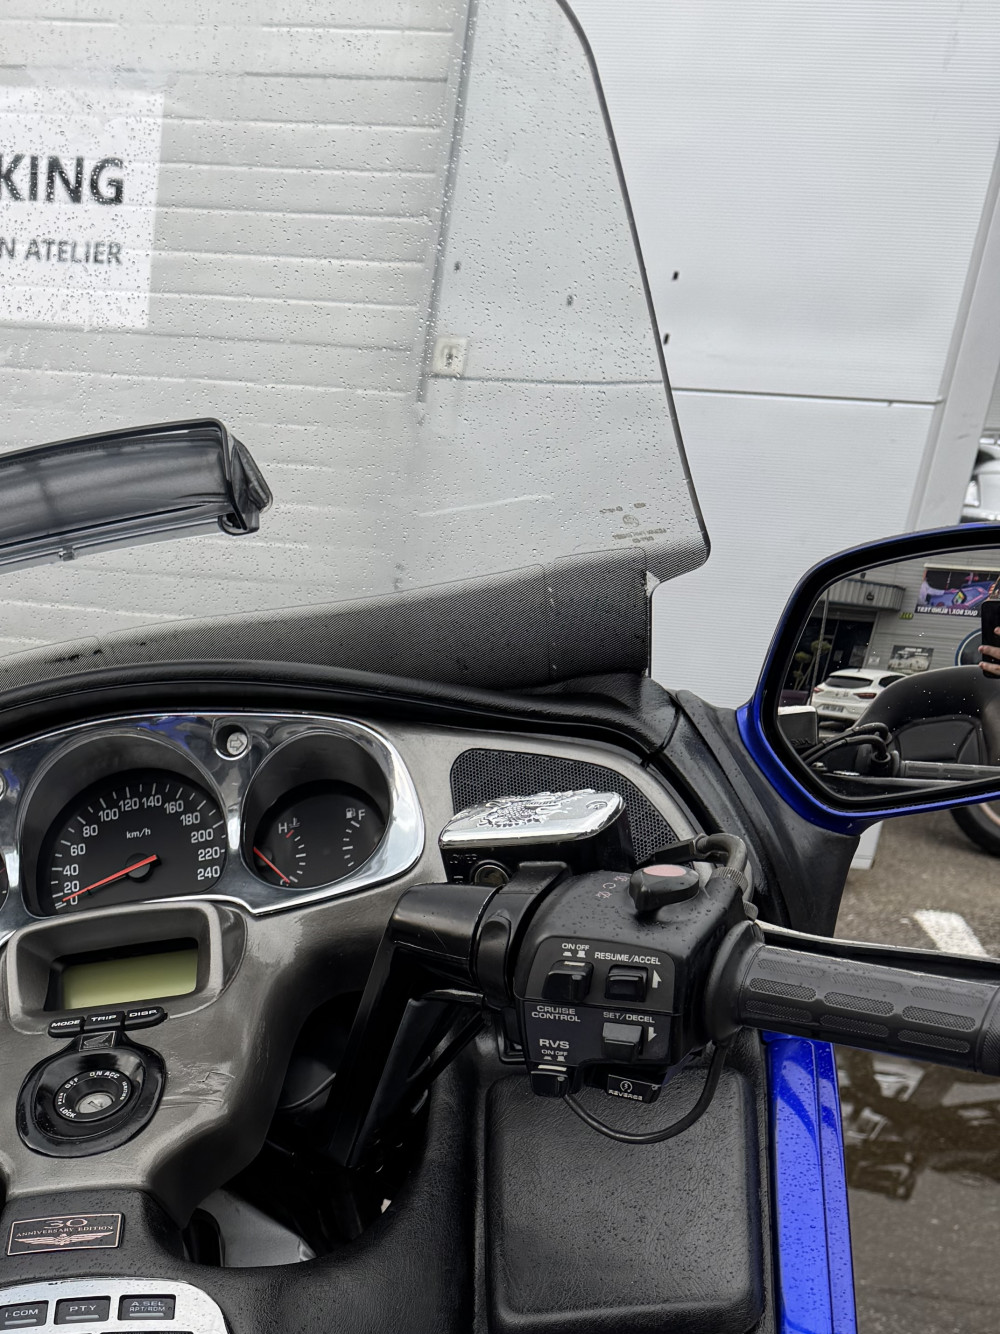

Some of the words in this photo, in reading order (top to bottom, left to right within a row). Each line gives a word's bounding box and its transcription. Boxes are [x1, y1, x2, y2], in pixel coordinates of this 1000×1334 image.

[25, 238, 123, 265] ATELIER
[118, 798, 139, 812] 120
[141, 794, 162, 809] 140
[164, 800, 184, 814] 160
[99, 808, 119, 822] 100
[180, 812, 200, 826] 180
[358, 809, 365, 820] F
[82, 824, 98, 838] 80
[126, 828, 151, 839] km/h
[278, 822, 287, 834] H
[191, 829, 214, 843] 200
[70, 844, 86, 856] 60
[198, 846, 220, 861] 220
[63, 864, 79, 876] 40
[197, 865, 221, 880] 240
[63, 880, 80, 894] 20
[594, 952, 661, 965] RESUME/ACCEL
[536, 1005, 576, 1014] CRUISE
[531, 1012, 581, 1022] CONTROL
[603, 1011, 655, 1023] SET/DECEL
[51, 1020, 80, 1028] MODE
[539, 1039, 570, 1049] RVS
[103, 1071, 120, 1079] ACC
[59, 1107, 76, 1118] LOCK
[44, 1219, 88, 1229] 30
[15, 1228, 74, 1237] ANNIVERSARY
